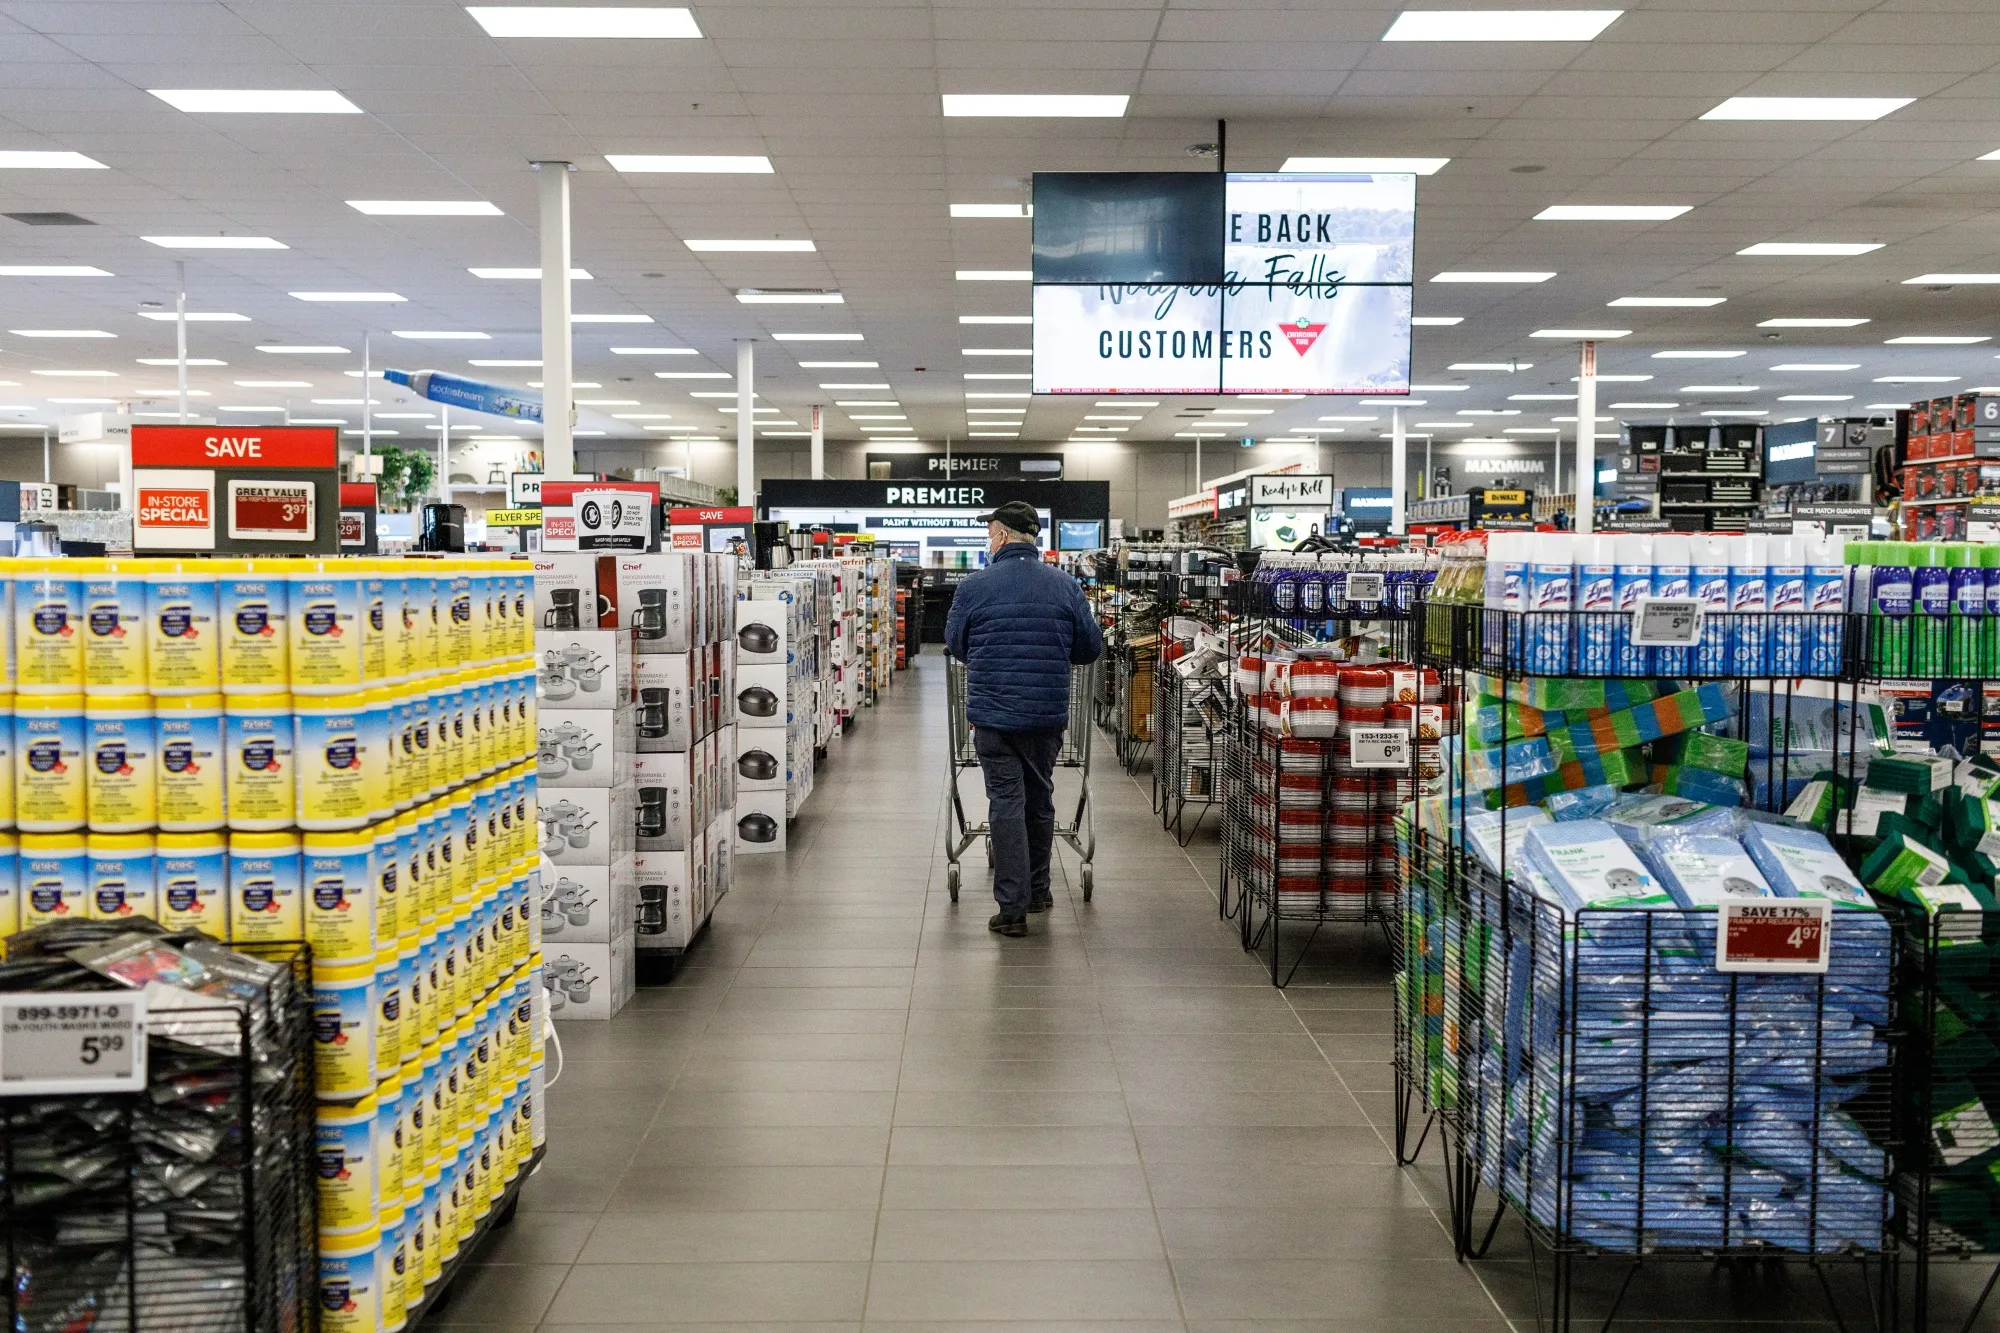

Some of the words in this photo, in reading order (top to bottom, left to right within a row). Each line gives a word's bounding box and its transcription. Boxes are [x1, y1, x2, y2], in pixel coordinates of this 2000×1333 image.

[1257, 213, 1331, 243] BACK
[1264, 254, 1346, 300] Falls
[1099, 330, 1273, 359] CUSTOMERS
[429, 384, 485, 402] sodastream
[1984, 402, 1998, 420] 6
[1825, 428, 1836, 442] 7
[205, 437, 262, 458] SAVE
[928, 458, 1000, 471] PREMIER
[1464, 459, 1545, 473] MAXIMUM
[1622, 457, 1632, 469] 9
[236, 488, 270, 496] GREAT
[273, 488, 307, 497] VALUE
[886, 487, 985, 504] PREMIER
[1261, 481, 1290, 499] Ready
[1300, 479, 1323, 496] Roll
[147, 496, 200, 507] IN-STORE
[140, 508, 208, 521] SPECIAL
[495, 513, 522, 522] FLYER
[700, 512, 724, 520] SAVE
[883, 519, 909, 527] PAINT
[910, 519, 951, 527] WITHOUT
[952, 519, 969, 527] THE
[535, 563, 555, 571] Chef
[622, 563, 642, 571] Chef
[1742, 908, 1777, 918] SAVE
[1782, 908, 1810, 918] 17%
